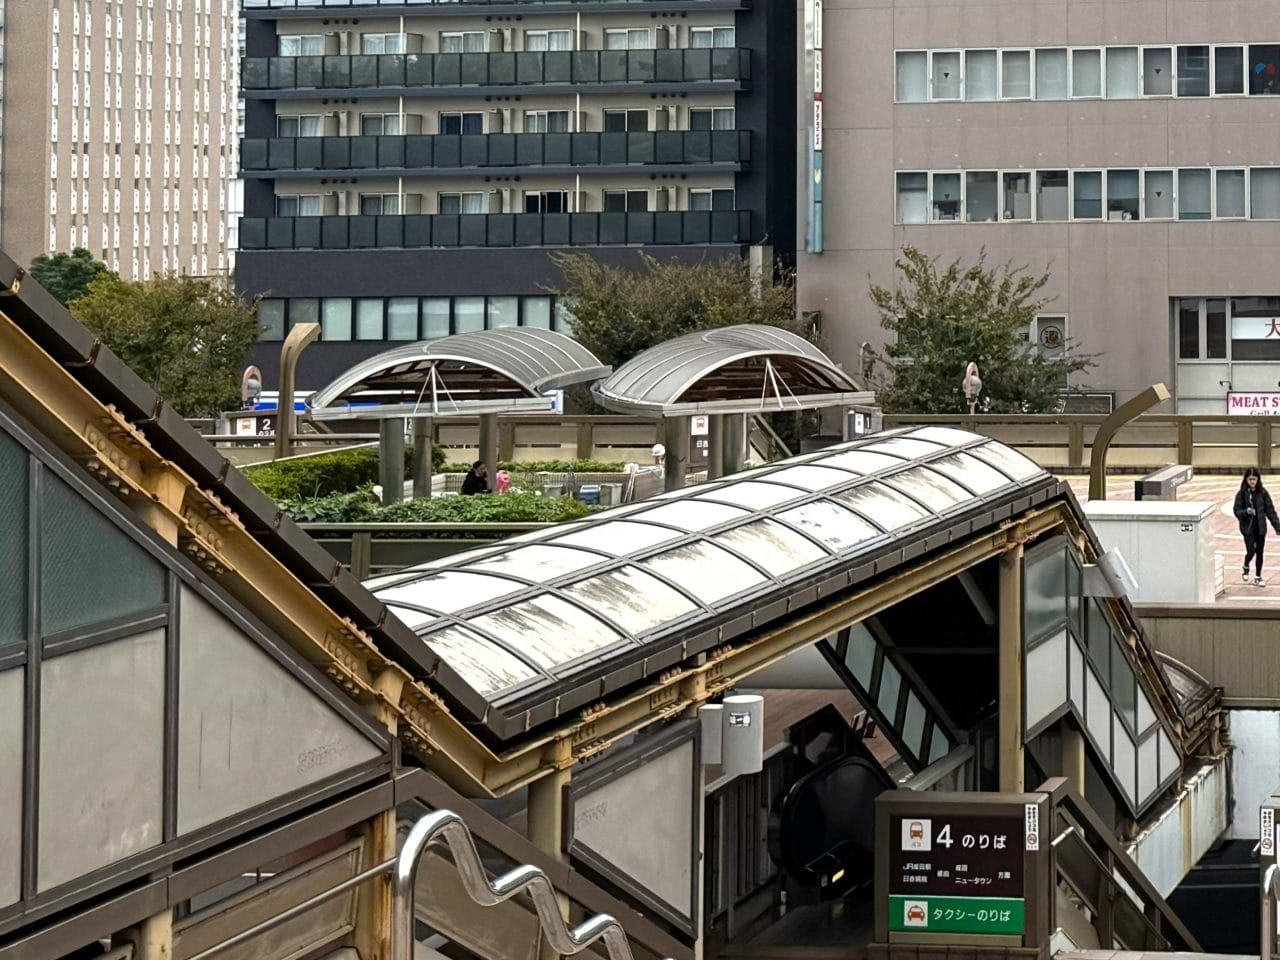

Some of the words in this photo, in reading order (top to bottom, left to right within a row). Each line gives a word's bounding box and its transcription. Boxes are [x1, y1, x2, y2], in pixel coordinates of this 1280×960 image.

[1232, 396, 1269, 408] MEAT
[262, 418, 271, 430] 2
[936, 824, 953, 848] 4
[962, 834, 1006, 849] のりば
[933, 909, 1011, 922] タクシーのりば
